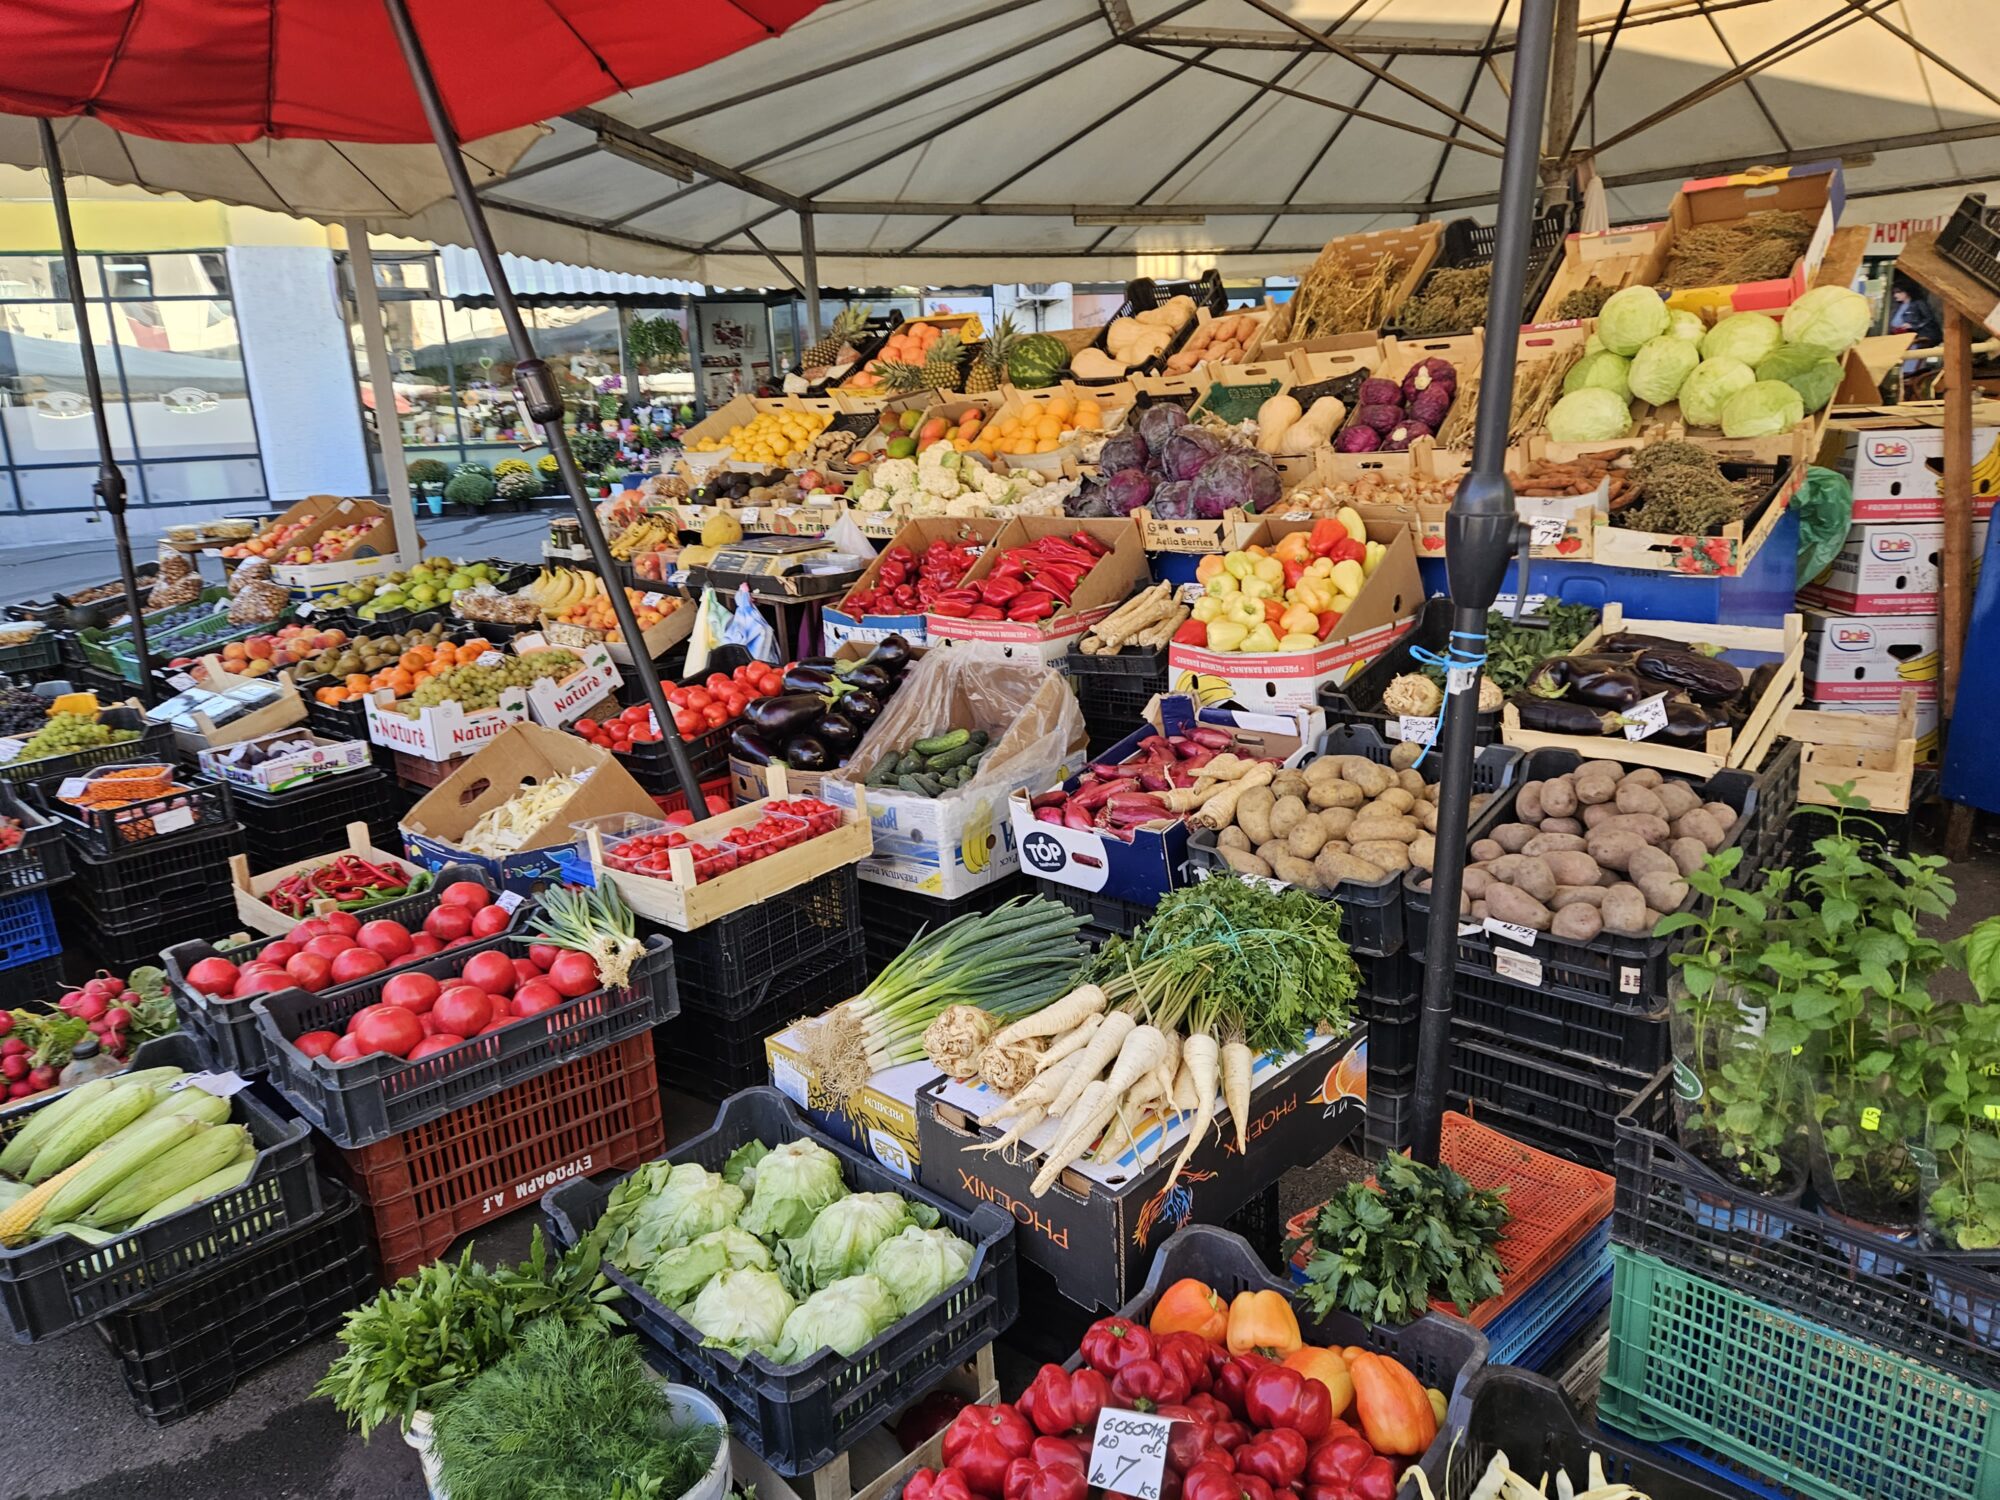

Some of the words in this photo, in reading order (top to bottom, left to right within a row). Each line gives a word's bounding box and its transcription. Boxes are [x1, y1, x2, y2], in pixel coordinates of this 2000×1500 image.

[1875, 443, 1907, 454] Dole
[1181, 538, 1213, 546] Berries
[1879, 539, 1911, 551] Dole
[1839, 629, 1871, 641] Dole
[1230, 665, 1263, 674] BANANAS
[1264, 665, 1299, 674] PREMIUM
[881, 868, 918, 884] PREMIUM
[864, 1096, 904, 1123] PREMIUM
[874, 1139, 905, 1170] Dole
[958, 1168, 1069, 1250] PHOENIX
[1108, 1454, 1142, 1489] 7
